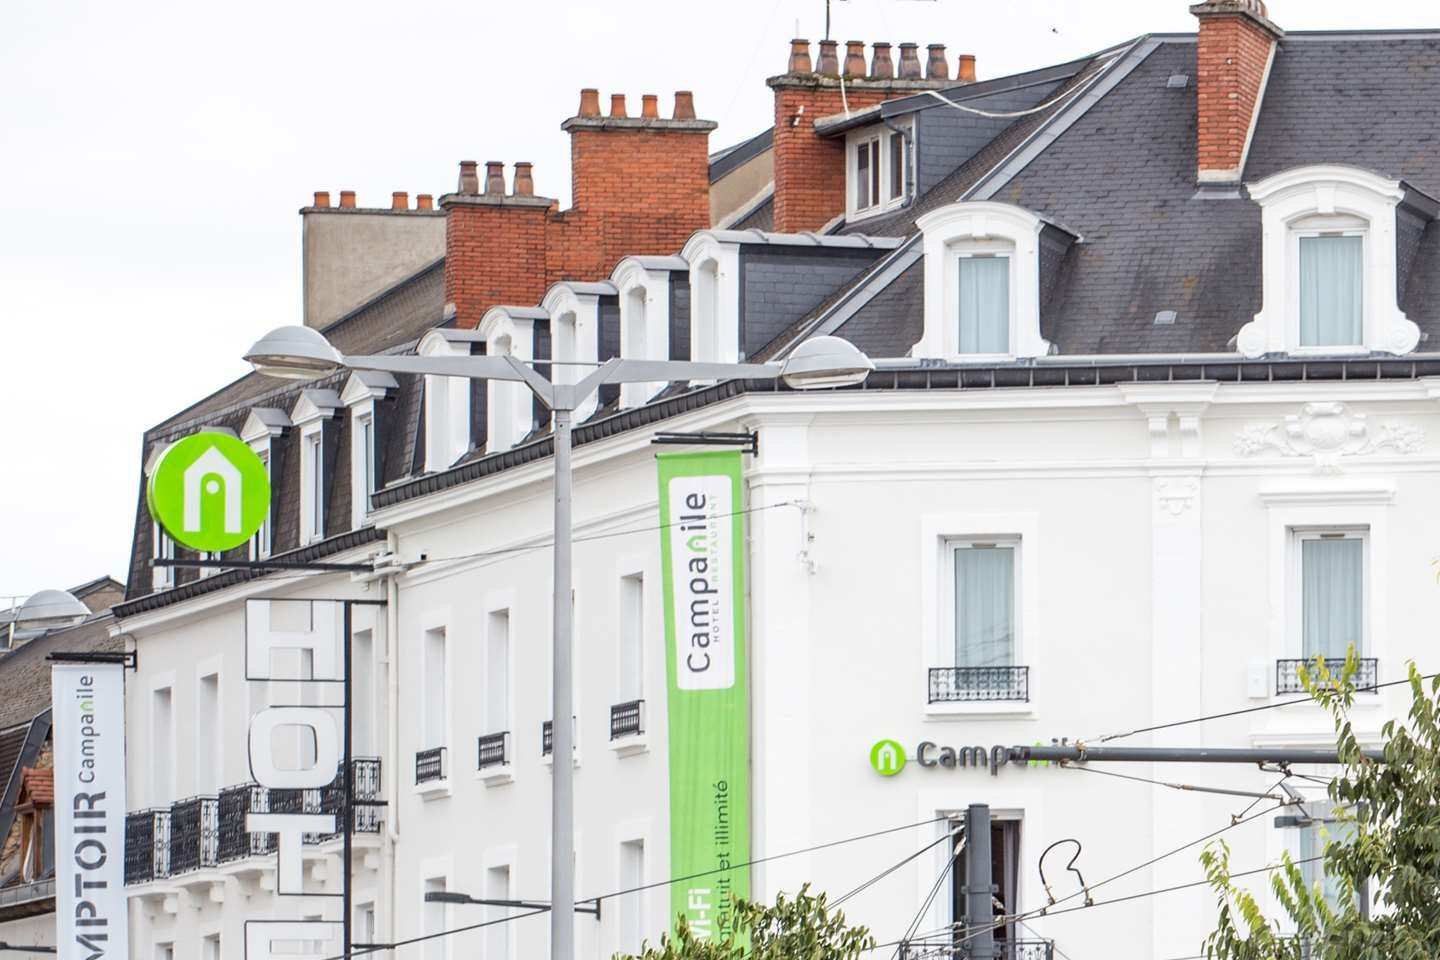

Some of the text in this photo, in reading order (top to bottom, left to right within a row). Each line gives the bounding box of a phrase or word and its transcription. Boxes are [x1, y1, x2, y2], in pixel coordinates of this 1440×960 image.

[680, 493, 718, 673] Campanile
[711, 600, 721, 643] HOTEL
[76, 675, 101, 784] Campanile
[712, 780, 729, 846] illimité
[717, 852, 731, 872] et
